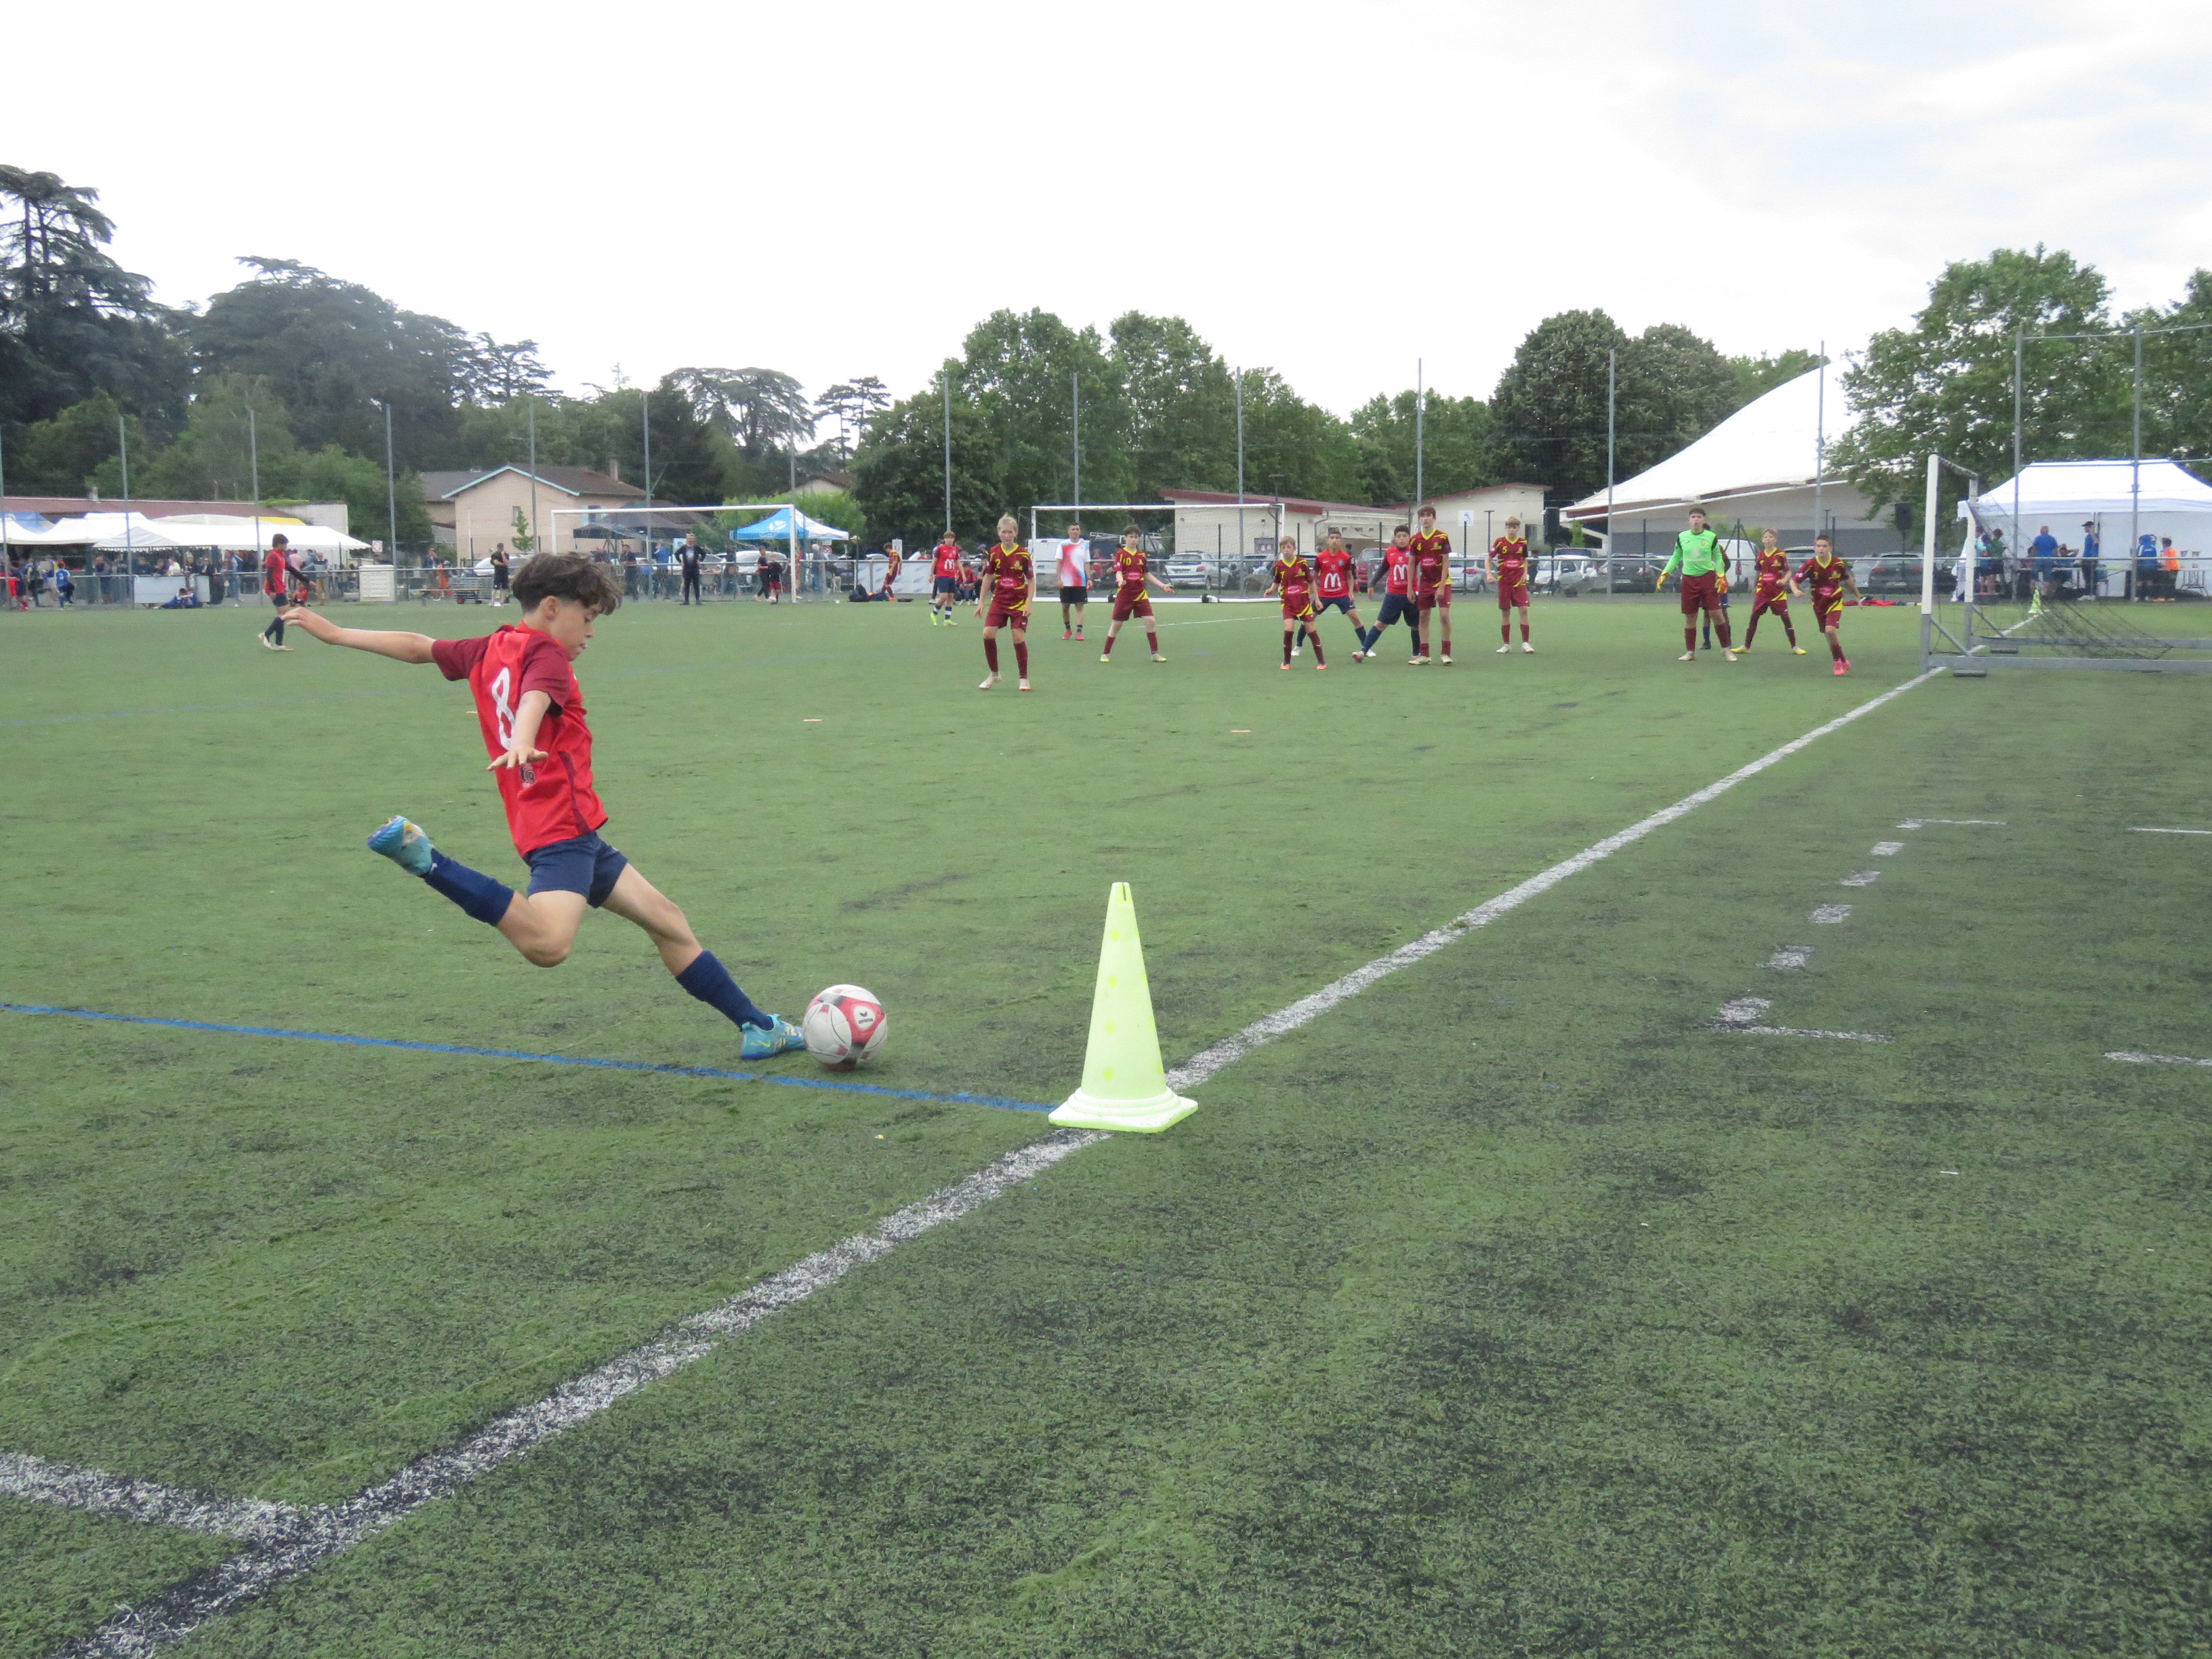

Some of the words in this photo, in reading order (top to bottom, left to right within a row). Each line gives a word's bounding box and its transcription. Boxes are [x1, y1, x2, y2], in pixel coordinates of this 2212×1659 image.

[1416, 543, 1422, 551] 4
[1502, 546, 1508, 554] 5
[995, 558, 1001, 569] 2
[1123, 557, 1132, 566] 10
[491, 667, 517, 752] 8
